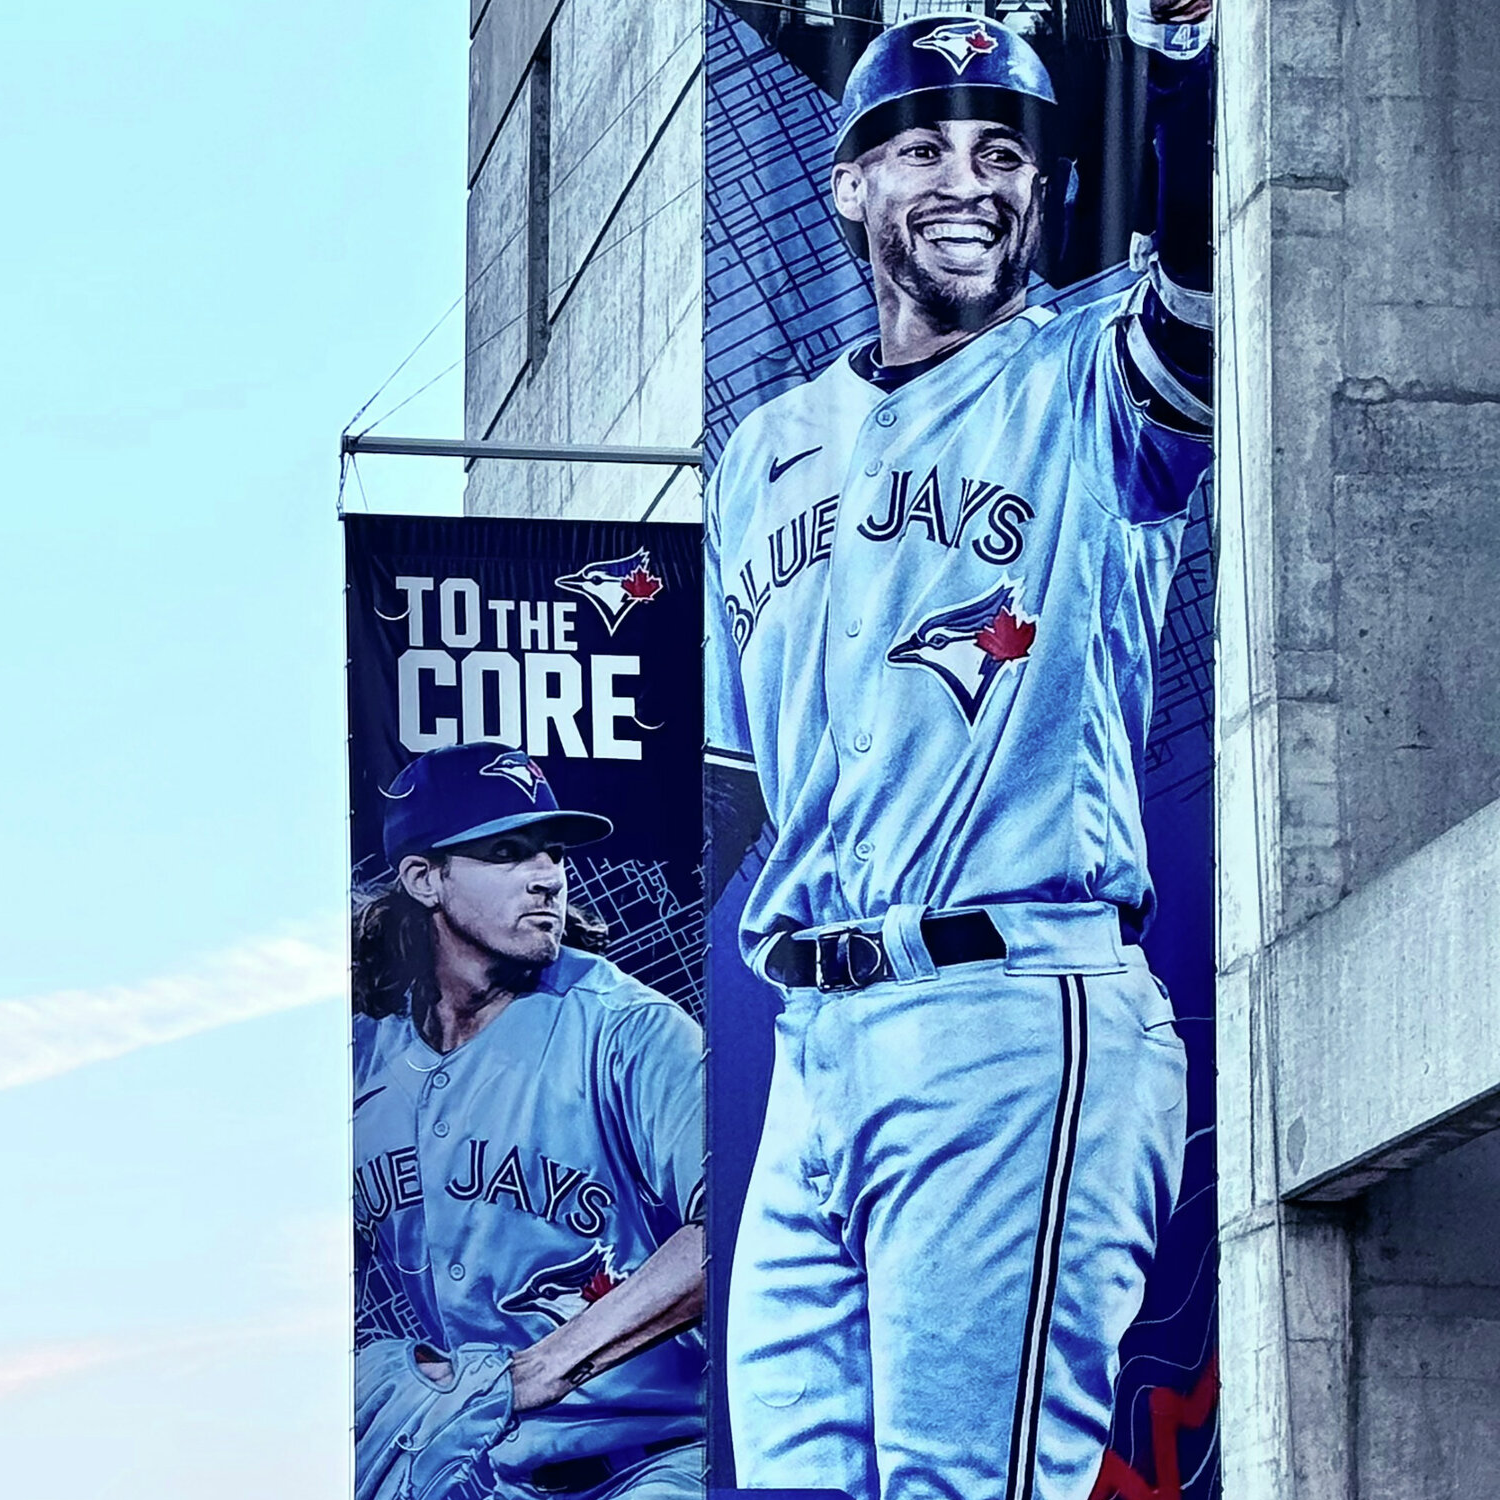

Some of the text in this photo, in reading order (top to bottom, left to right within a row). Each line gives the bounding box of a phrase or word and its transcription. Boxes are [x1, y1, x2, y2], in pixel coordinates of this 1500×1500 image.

[395, 575, 578, 651] TO THE
[725, 465, 1036, 658] BLUE JAYS
[397, 648, 643, 761] CORE
[445, 1138, 618, 1239] JAYS
